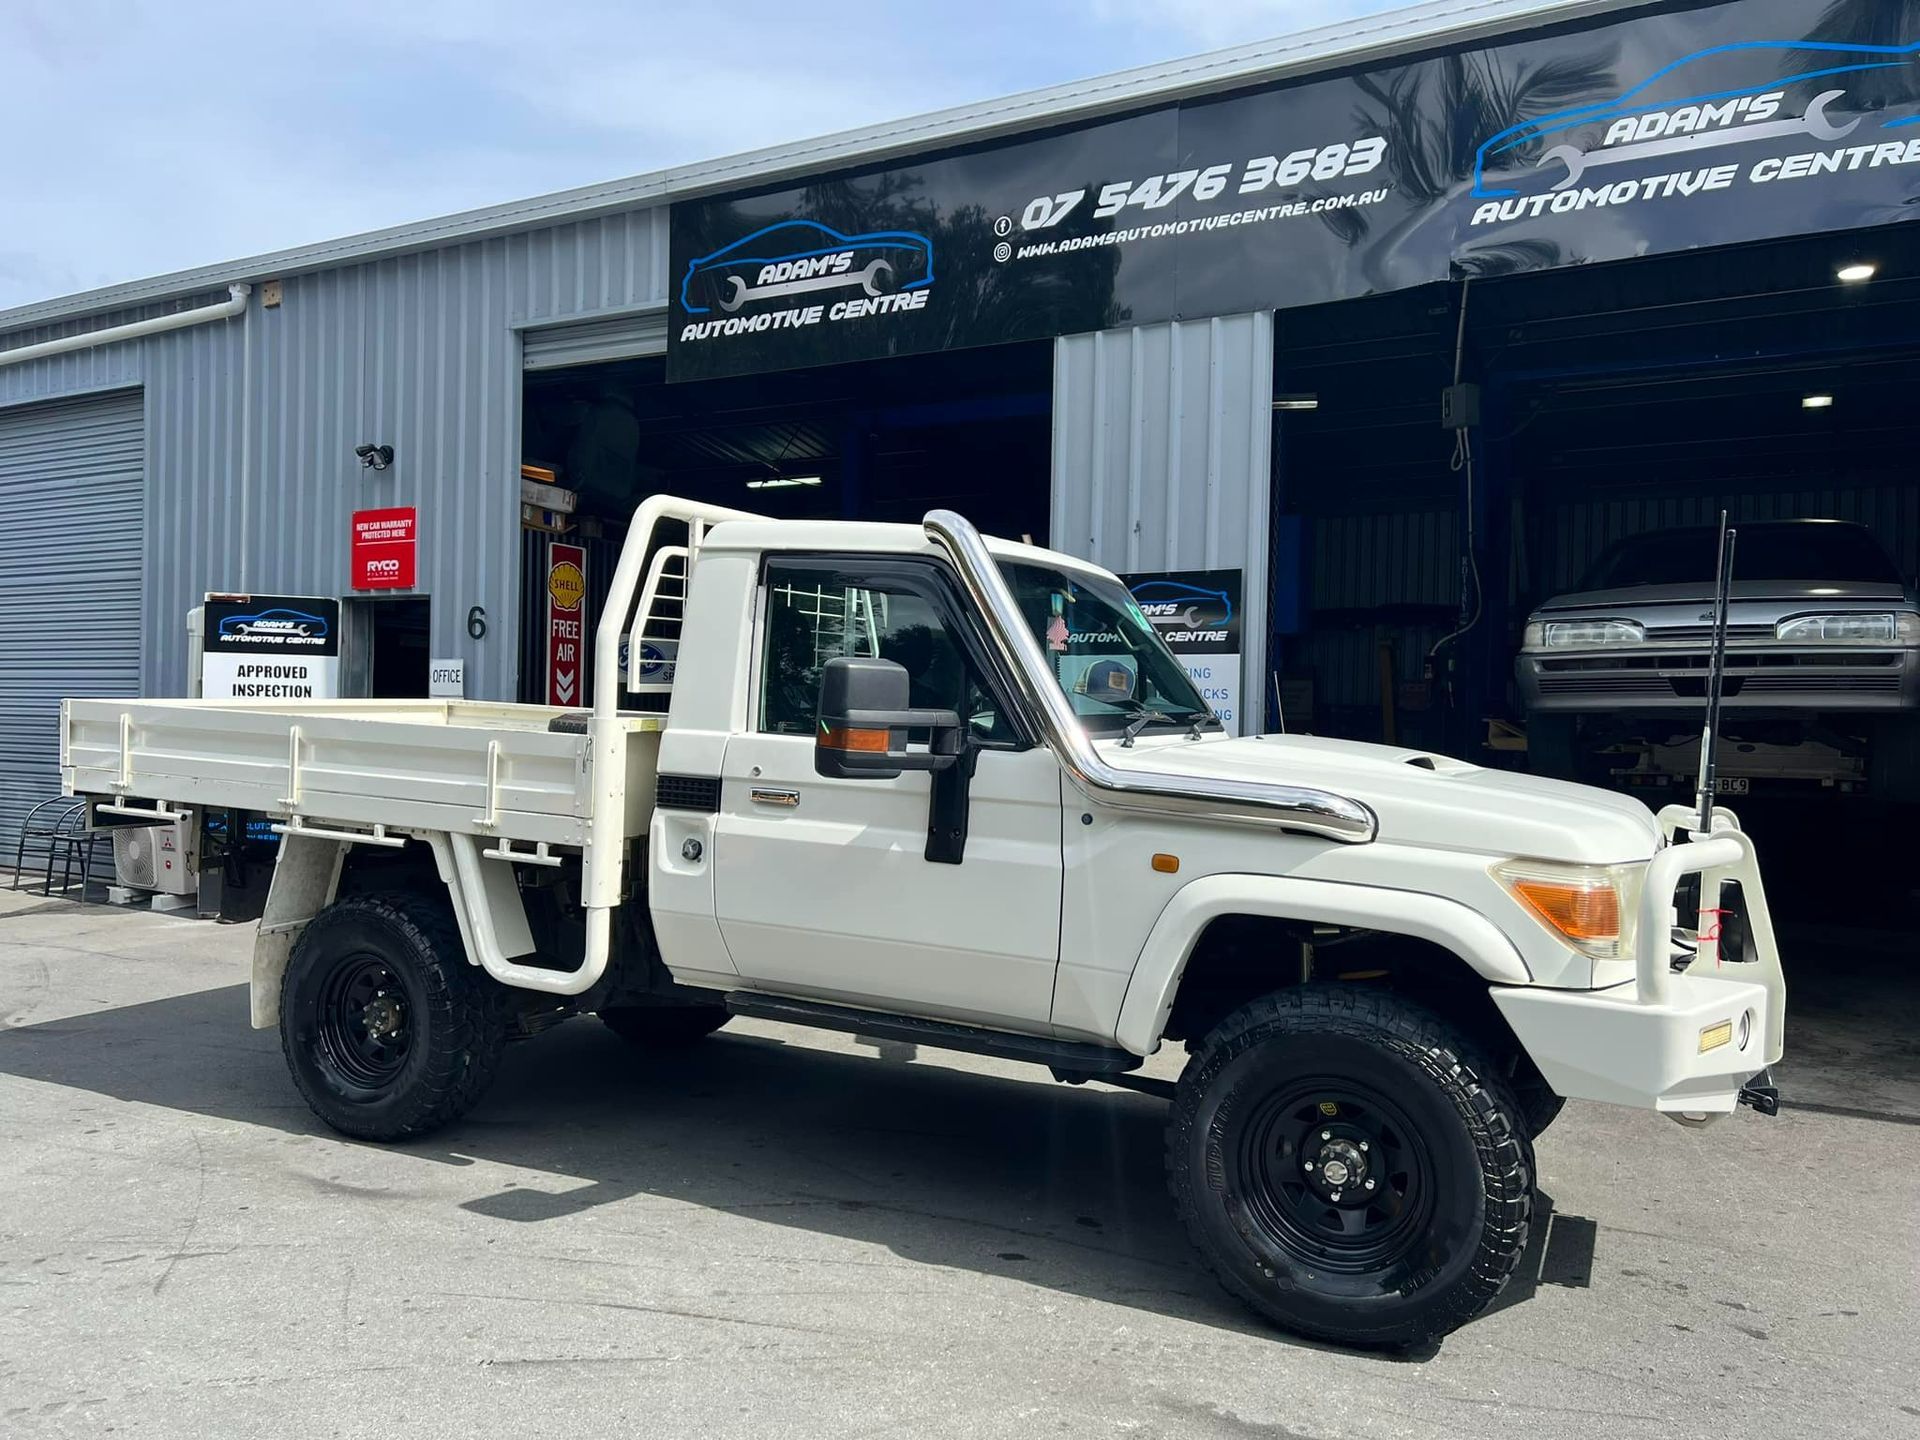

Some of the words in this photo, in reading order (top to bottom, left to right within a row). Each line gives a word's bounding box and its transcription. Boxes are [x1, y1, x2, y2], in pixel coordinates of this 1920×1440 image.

[1603, 91, 1785, 146] ADAM'S
[1020, 189, 1085, 231] 07
[1093, 163, 1232, 219] 5476
[1238, 135, 1388, 194] 3683
[1470, 163, 1739, 226] AUTOMOTIVE
[1749, 139, 1920, 184] CENTRE
[1017, 188, 1388, 259] WWW.ADAMSAUTOMOTIVECENTRE.COM.AU
[757, 251, 854, 286] ADAM'S
[680, 304, 824, 342] AUTOMOTIVE
[829, 289, 931, 321] CENTRE
[356, 523, 369, 531] NEW
[369, 521, 381, 530] CAR
[381, 519, 413, 529] WARRANTY
[361, 530, 391, 540] PROTECTED
[391, 528, 406, 537] HERE
[367, 560, 399, 572] RYCO
[554, 579, 579, 592] SHELL
[253, 620, 295, 628] ADAM'S
[467, 606, 486, 640] 6
[552, 619, 579, 639] FREE
[220, 634, 285, 644] AUTOMOTIVE
[286, 637, 327, 645] CENTRE
[1165, 630, 1228, 642] CENTRE
[556, 643, 575, 662] AIR
[237, 665, 308, 679] APPROVED
[432, 669, 461, 683] OFFICE
[232, 683, 312, 698] INSPECTION
